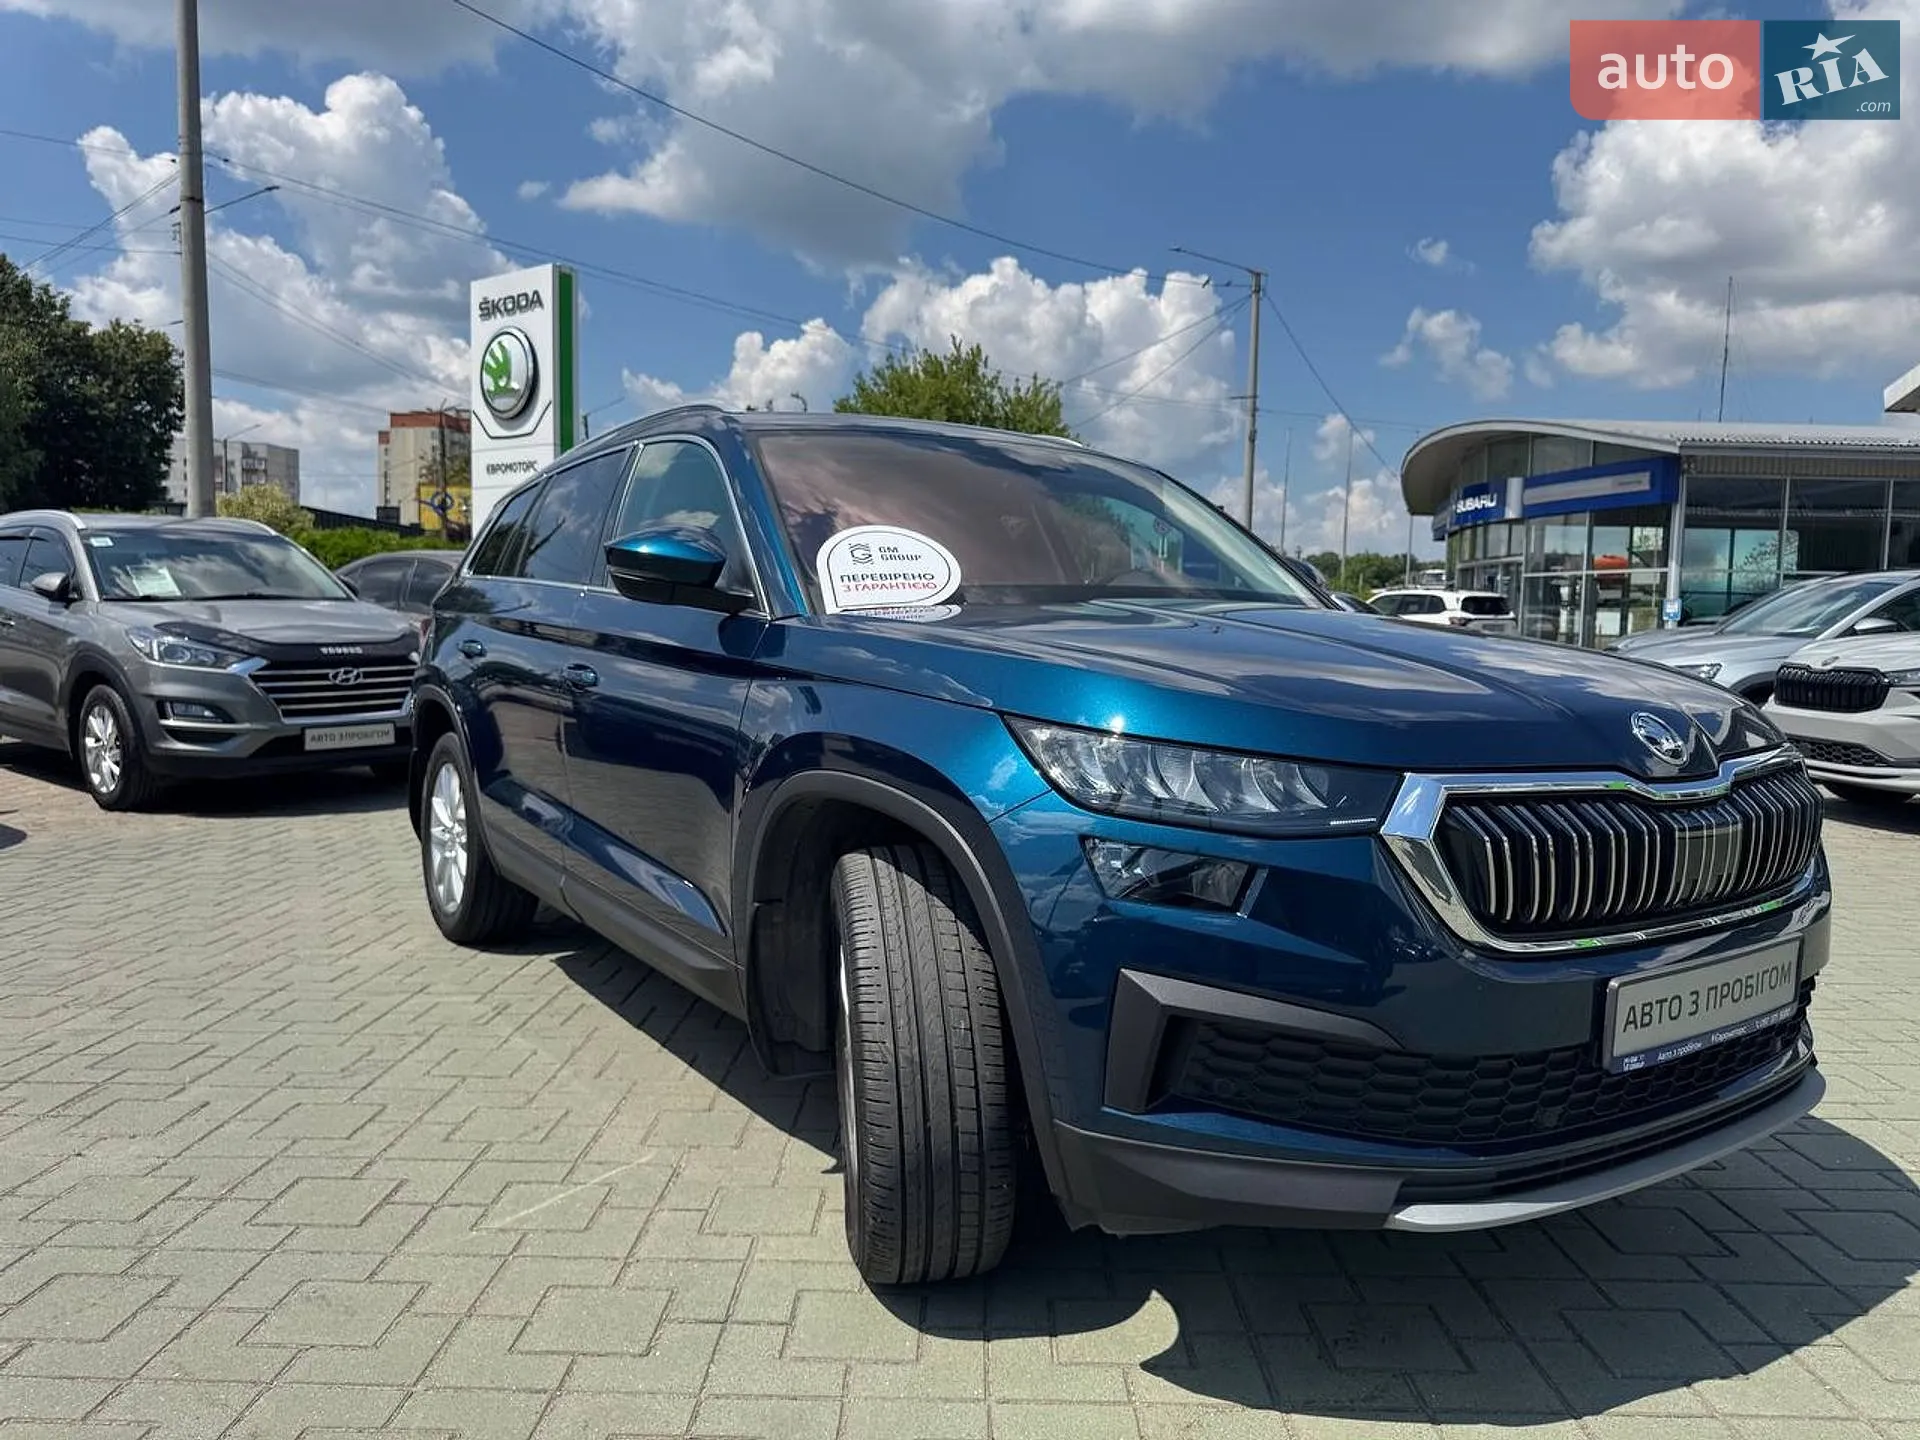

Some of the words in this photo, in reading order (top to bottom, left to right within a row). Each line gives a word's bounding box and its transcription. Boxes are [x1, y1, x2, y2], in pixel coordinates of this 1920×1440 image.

[478, 290, 543, 316] ŠKODA
[1456, 493, 1497, 513] SUBARU
[880, 553, 921, 561] GROUP
[840, 573, 935, 583] ПЕРЕВІРЕНО
[855, 582, 937, 592] ГАРАНТІЄЮ
[1623, 994, 1682, 1033] АВТО
[1705, 961, 1793, 1012] ПРОБІГОМ
